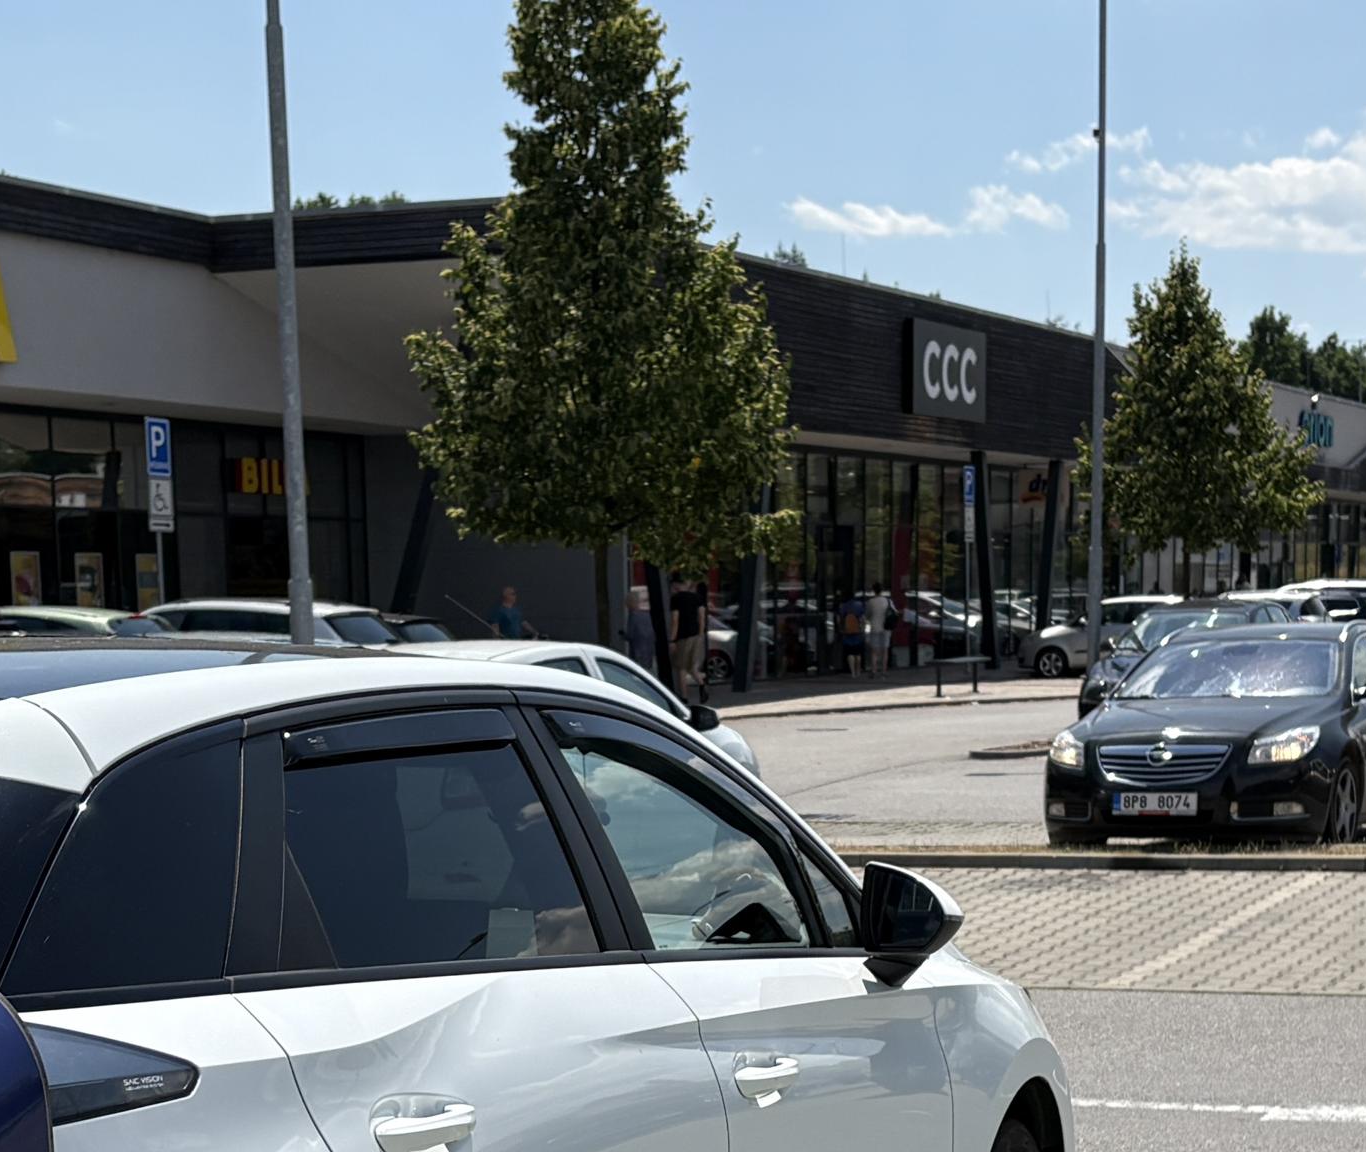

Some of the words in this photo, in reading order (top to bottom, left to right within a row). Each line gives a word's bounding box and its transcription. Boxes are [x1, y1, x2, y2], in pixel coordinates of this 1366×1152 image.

[923, 340, 978, 405] CCC
[150, 425, 165, 459] P
[236, 457, 311, 496] BIL
[1123, 795, 1148, 809] 8P8
[1157, 795, 1191, 809] 8074
